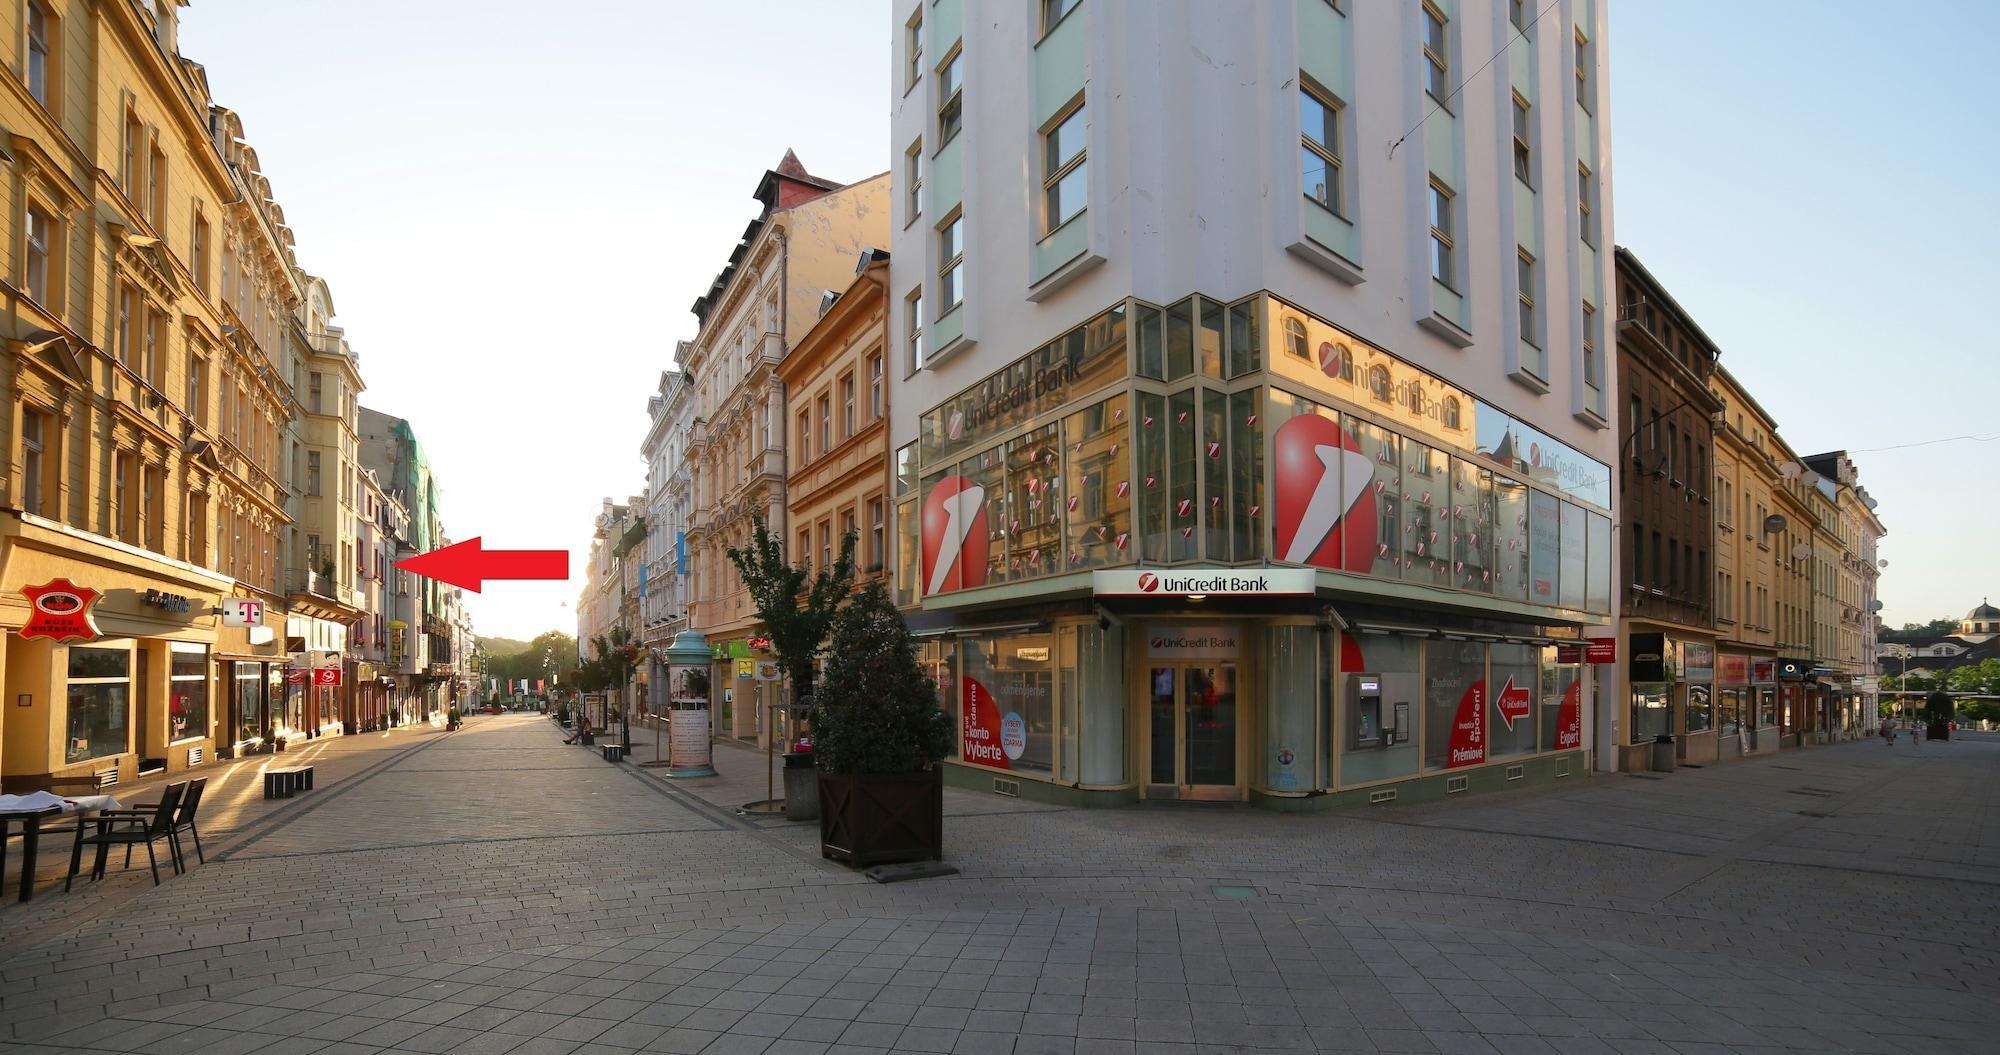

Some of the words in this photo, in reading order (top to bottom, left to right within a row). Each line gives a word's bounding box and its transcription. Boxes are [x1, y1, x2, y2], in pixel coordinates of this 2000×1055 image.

[1339, 349, 1414, 407] niCedi
[965, 379, 1030, 431] UniCredit
[1035, 358, 1081, 398] Bank
[1541, 448, 1578, 484] UniCredit
[1579, 466, 1598, 493] Bank
[1164, 576, 1227, 592] UniCredit
[1231, 576, 1268, 592] Bank
[1163, 637, 1208, 648] UniCredit
[1210, 637, 1236, 648] Bank
[1473, 689, 1481, 743] spoření
[970, 726, 989, 740] konto
[1560, 730, 1579, 747] Expert
[965, 740, 1002, 761] Vyberte
[1453, 744, 1483, 763] Prémiové
